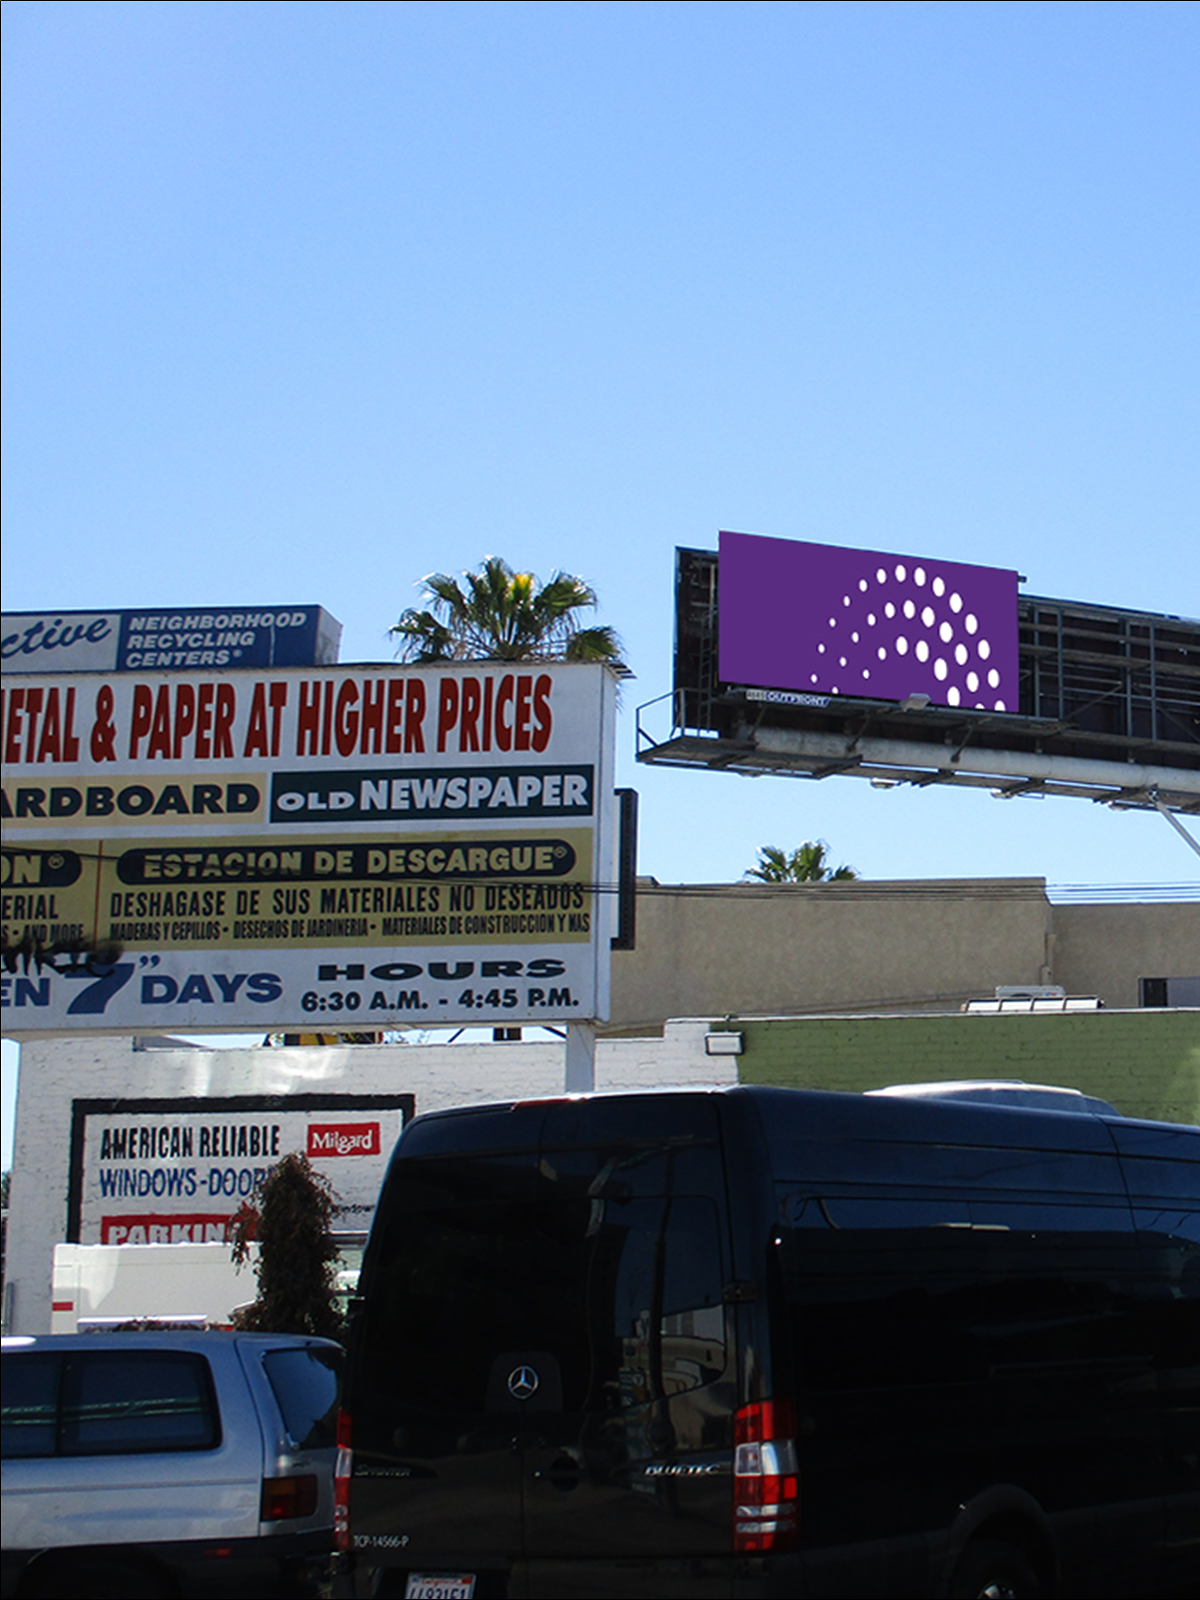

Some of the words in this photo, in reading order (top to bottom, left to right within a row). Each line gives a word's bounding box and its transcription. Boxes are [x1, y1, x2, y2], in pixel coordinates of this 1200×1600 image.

[129, 612, 307, 631] NEIGHBORHOOD
[127, 632, 256, 650] RECYCLING
[1, 686, 80, 764] ETAL
[90, 684, 117, 763] &
[128, 683, 236, 760] PAPER
[243, 682, 288, 758] AT
[296, 678, 426, 757] HIGHER
[436, 674, 553, 753] PRICES
[276, 791, 355, 811] OLD
[360, 774, 589, 811] NEWSPAPER
[143, 851, 302, 878] ESTACION
[314, 850, 353, 875] DE
[110, 889, 226, 918] DESHAGASE
[236, 890, 260, 915] DE
[273, 888, 311, 915] SUS
[320, 885, 440, 913] MATERIALES
[450, 885, 475, 912] NO
[485, 882, 584, 912] DESEADOS
[25, 924, 48, 942] AND
[50, 924, 84, 942] MORE
[110, 922, 160, 941] MADERAS
[162, 921, 171, 940] Y
[171, 921, 221, 940] CEPILLOS
[233, 919, 290, 939] DESECHOS
[291, 919, 304, 938] DE
[306, 918, 368, 938] JARDINERIA
[382, 916, 448, 936] MATERIALES
[450, 914, 463, 934] DE
[464, 913, 555, 934] CONSTRUCCION
[557, 912, 566, 933] Y
[318, 959, 566, 981] HOURS
[141, 973, 283, 1004] DAYS
[301, 991, 361, 1012] 6:30
[369, 991, 428, 1010] A.M.
[459, 989, 518, 1009] 4:45
[528, 988, 579, 1007] P.M.
[100, 1126, 194, 1160] AMERICAN
[200, 1125, 280, 1157] RELIABLE
[312, 1130, 373, 1155] Milgard
[108, 1223, 242, 1245] PARKIN
